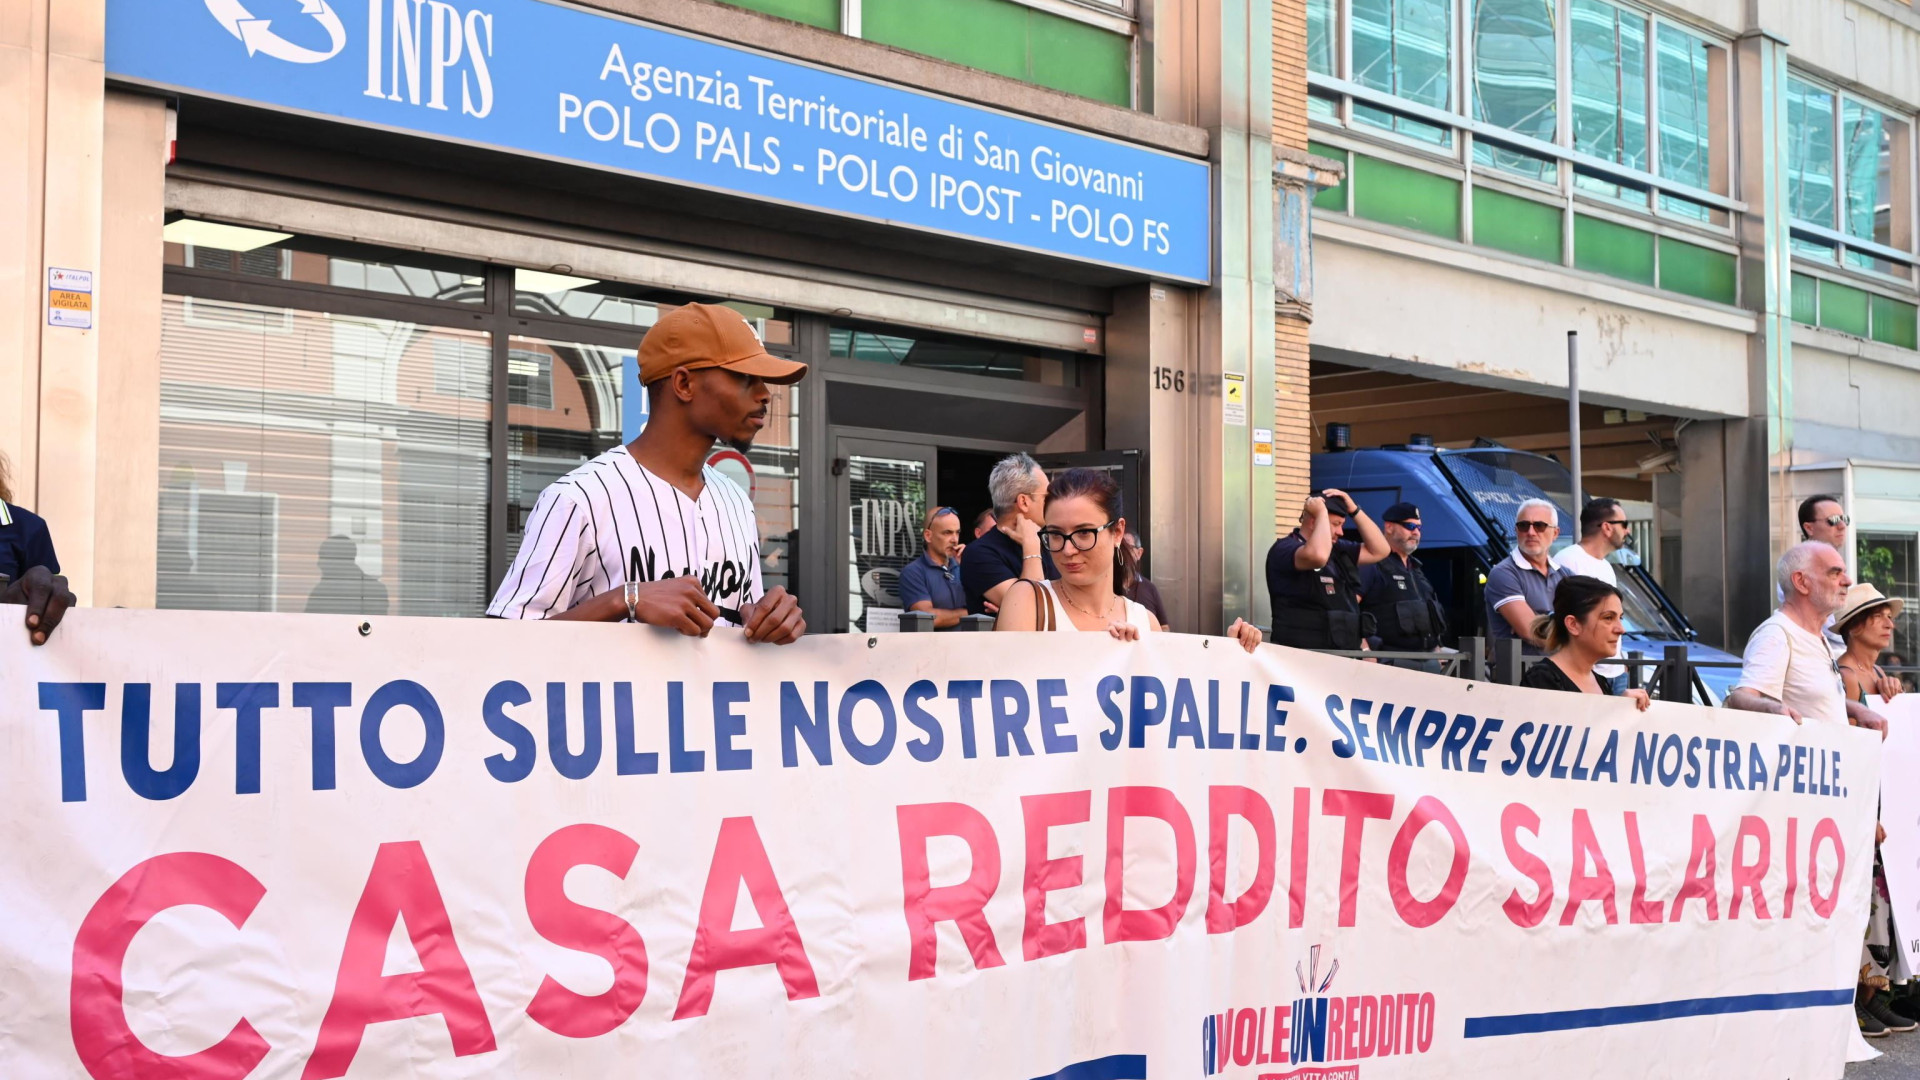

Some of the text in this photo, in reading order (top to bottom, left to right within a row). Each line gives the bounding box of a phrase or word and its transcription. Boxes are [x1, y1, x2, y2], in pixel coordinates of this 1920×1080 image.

[364, 0, 494, 119] INPS
[559, 92, 681, 154] POLO
[696, 121, 781, 175] PALS
[818, 148, 918, 202] POLO
[930, 172, 1022, 224] IPOST
[1051, 199, 1134, 247] POLO
[1143, 219, 1170, 255] FS
[600, 43, 1143, 201] Agenzia Territoriale di San Giovanni
[53, 299, 88, 308] VIGILATA
[60, 292, 81, 300] AREA
[1153, 366, 1185, 393] 156
[860, 498, 918, 558] INPS
[38, 675, 1848, 802] TUTTO SULLE NOSTRE SPALLE. SEMPRE SULLA NOSTRA PELLE.
[70, 815, 821, 1080] CASA
[896, 784, 1471, 982] REDDITO
[1501, 802, 1846, 929] SALARIO
